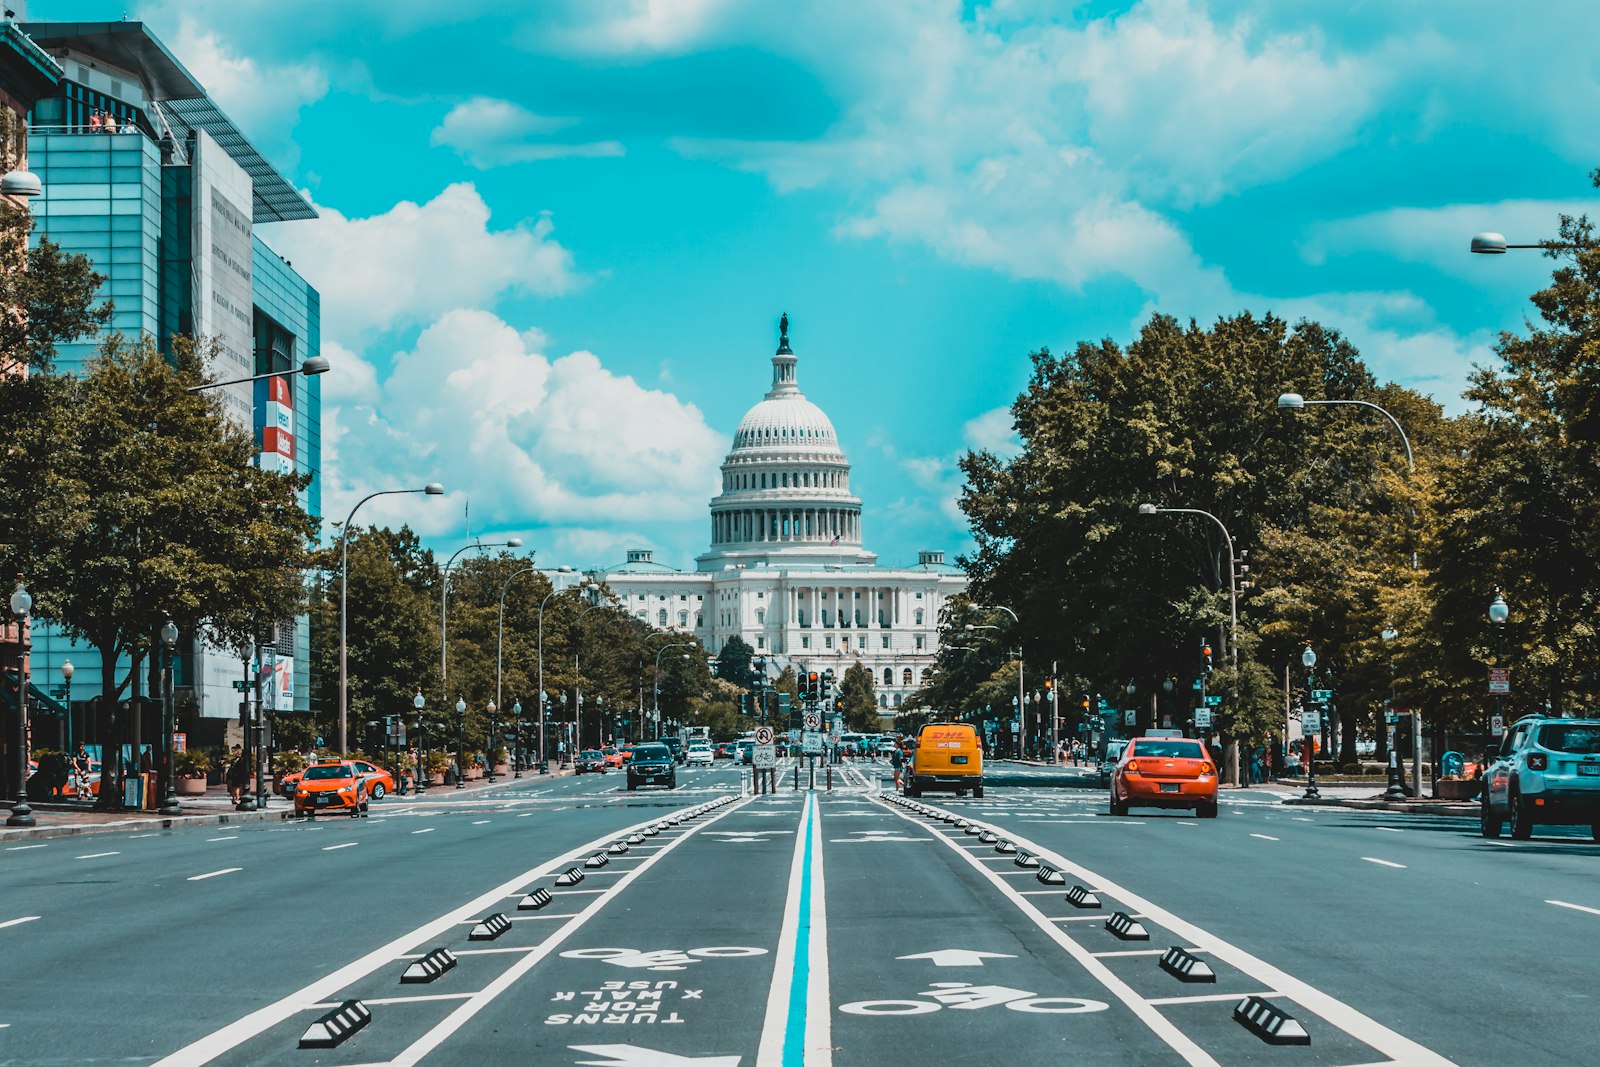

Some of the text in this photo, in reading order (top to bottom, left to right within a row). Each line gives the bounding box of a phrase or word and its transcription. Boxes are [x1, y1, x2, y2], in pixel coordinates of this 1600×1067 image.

[600, 980, 678, 990] USE
[551, 989, 704, 1001] X WALK
[583, 1001, 661, 1012] FOR
[544, 1012, 685, 1024] TURNS
